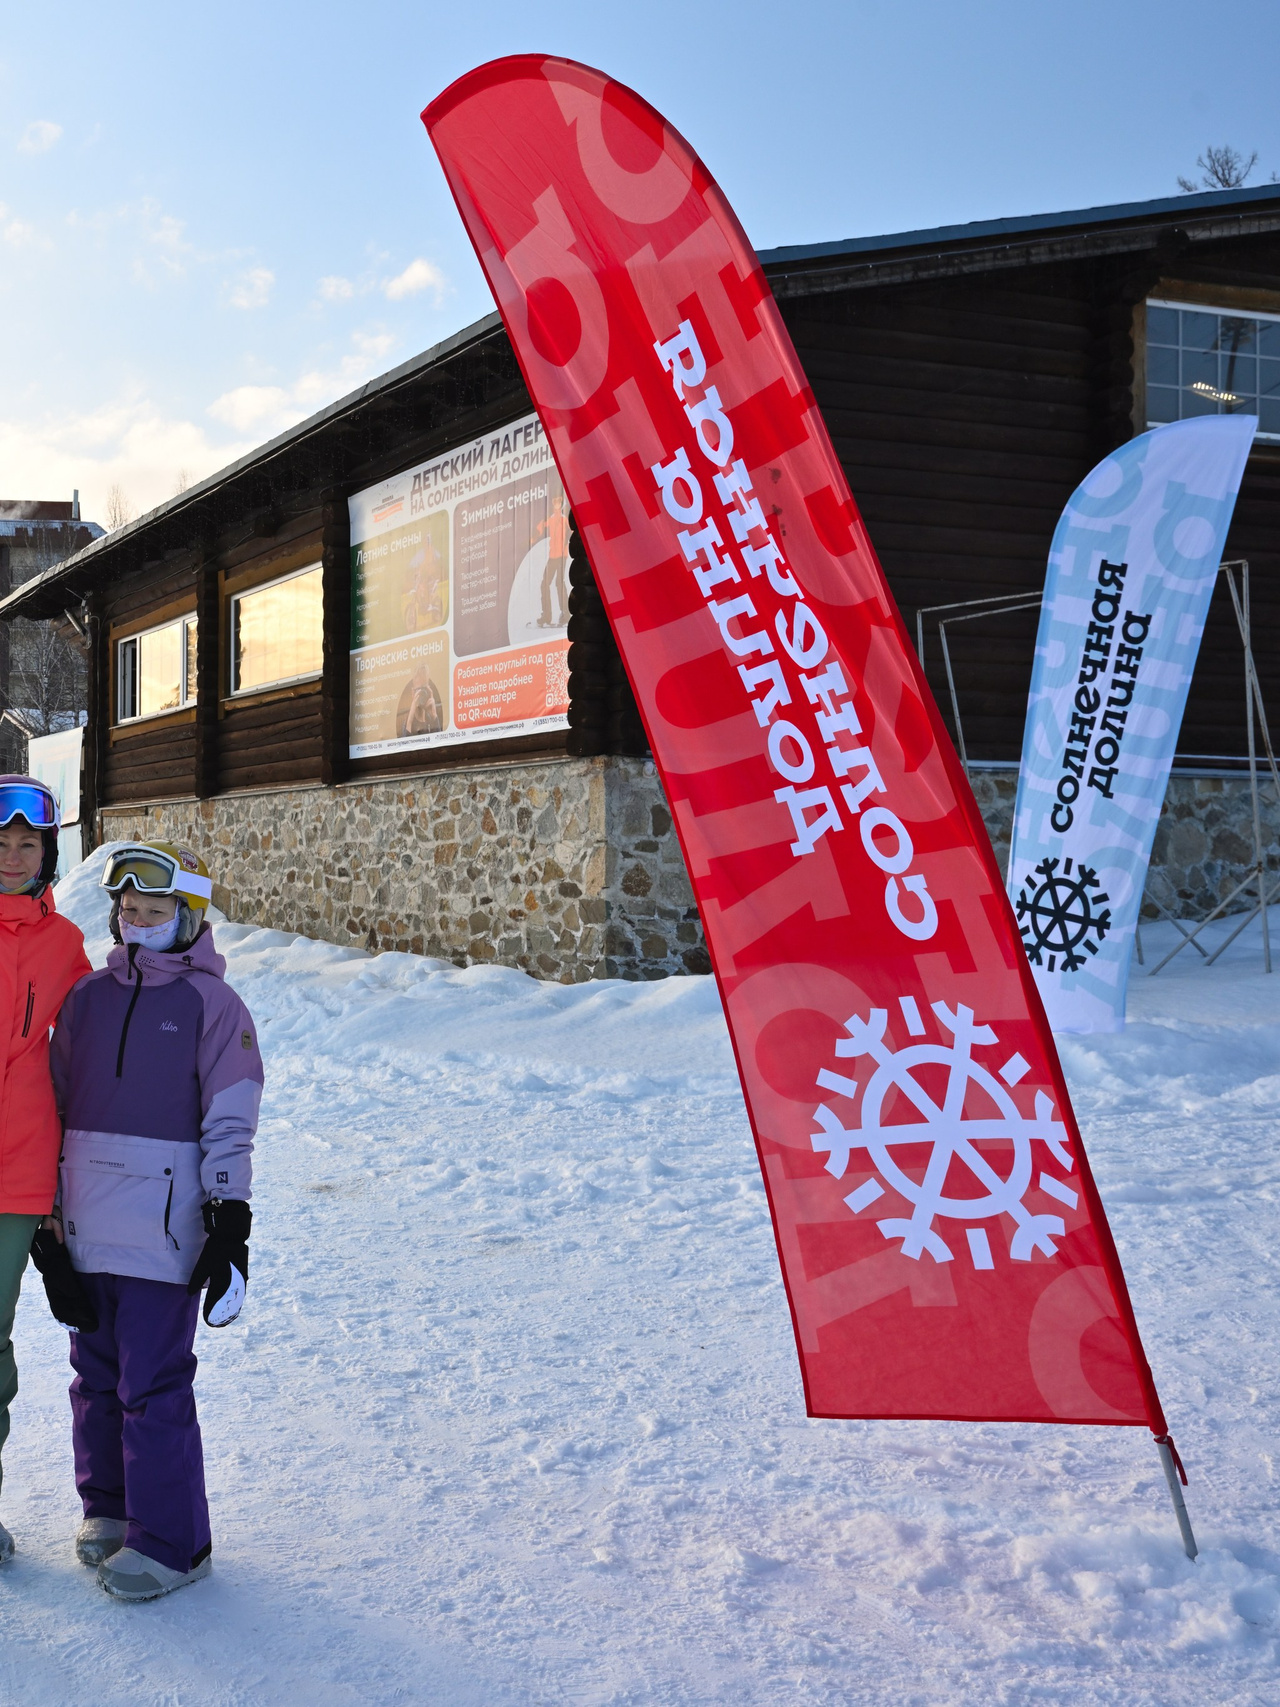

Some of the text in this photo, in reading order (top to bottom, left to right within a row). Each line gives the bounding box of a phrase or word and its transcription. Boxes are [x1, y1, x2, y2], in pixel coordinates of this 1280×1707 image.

[410, 420, 545, 498] ДЕТСКИЙ ЛАГЕР
[410, 498, 425, 516] НА
[428, 463, 498, 508] СОЛНЕЧНОЙ
[461, 483, 548, 528] Зимние смены
[356, 531, 422, 566] Летние смены
[355, 640, 443, 673] Творческие смены
[457, 654, 543, 680] Работаем круглый год
[457, 674, 533, 697] Узнайте подробнее
[458, 691, 517, 709] о нашем лагере
[1051, 559, 1128, 833] солнечная
[458, 707, 502, 722] по QR-коду
[1087, 610, 1153, 799] долина
